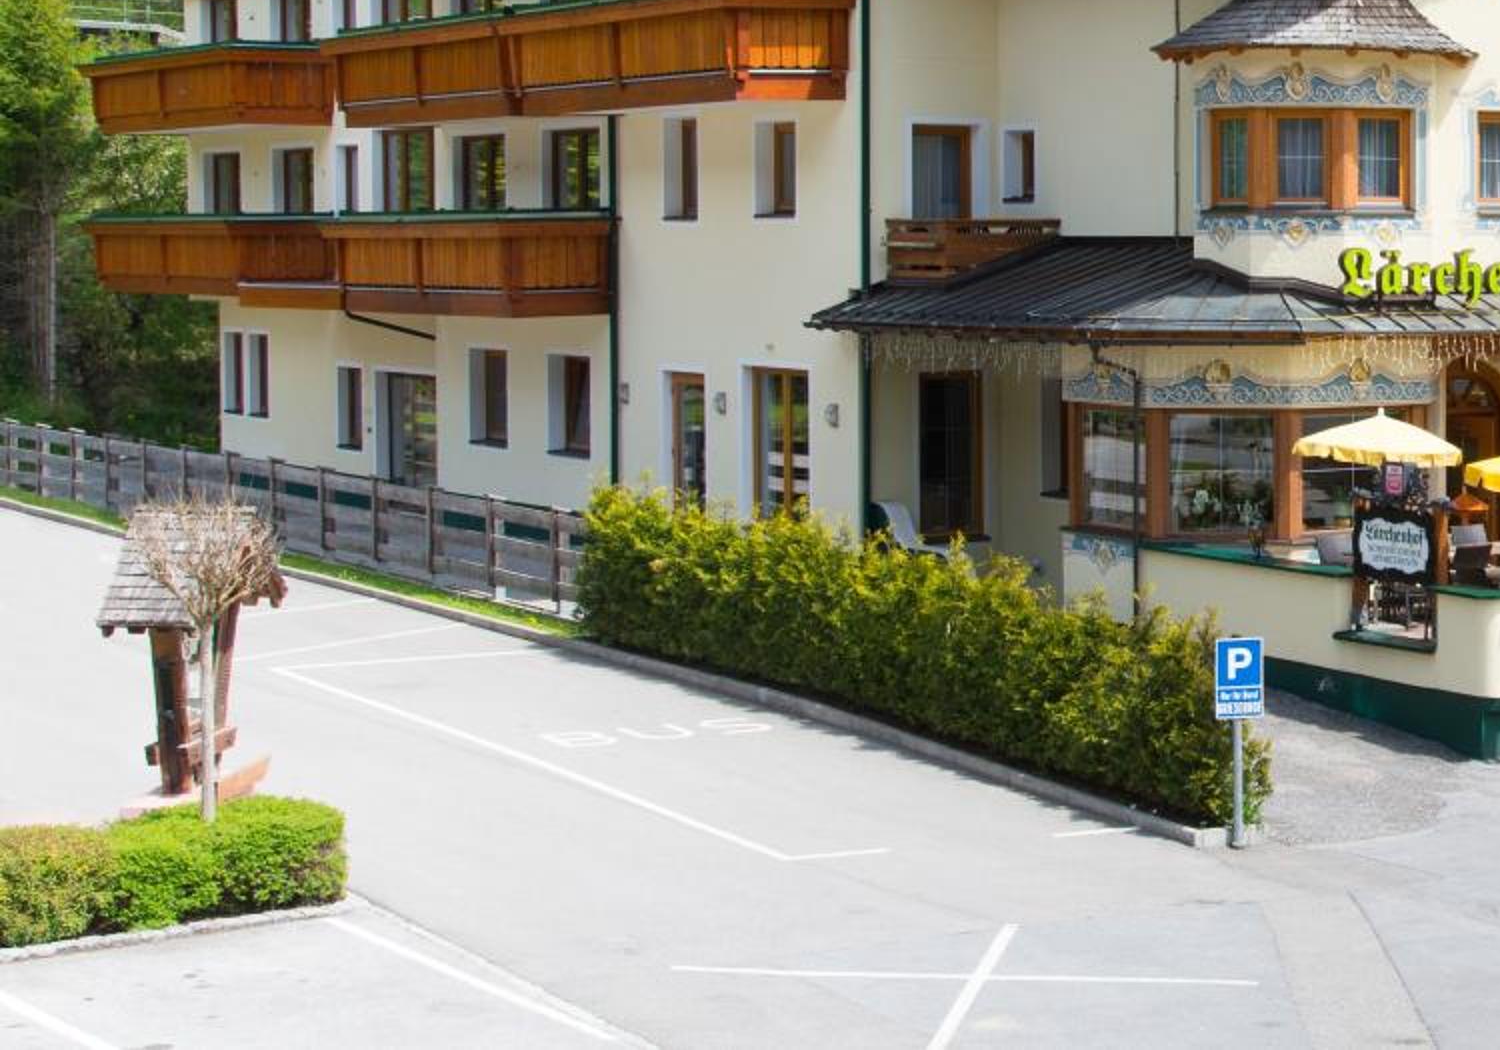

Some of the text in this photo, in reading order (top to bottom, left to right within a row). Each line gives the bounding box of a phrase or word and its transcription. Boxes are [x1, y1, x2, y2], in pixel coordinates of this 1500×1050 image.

[1365, 524, 1424, 547] Lärchenhof
[1227, 647, 1253, 680] P
[539, 718, 772, 749] BUS
